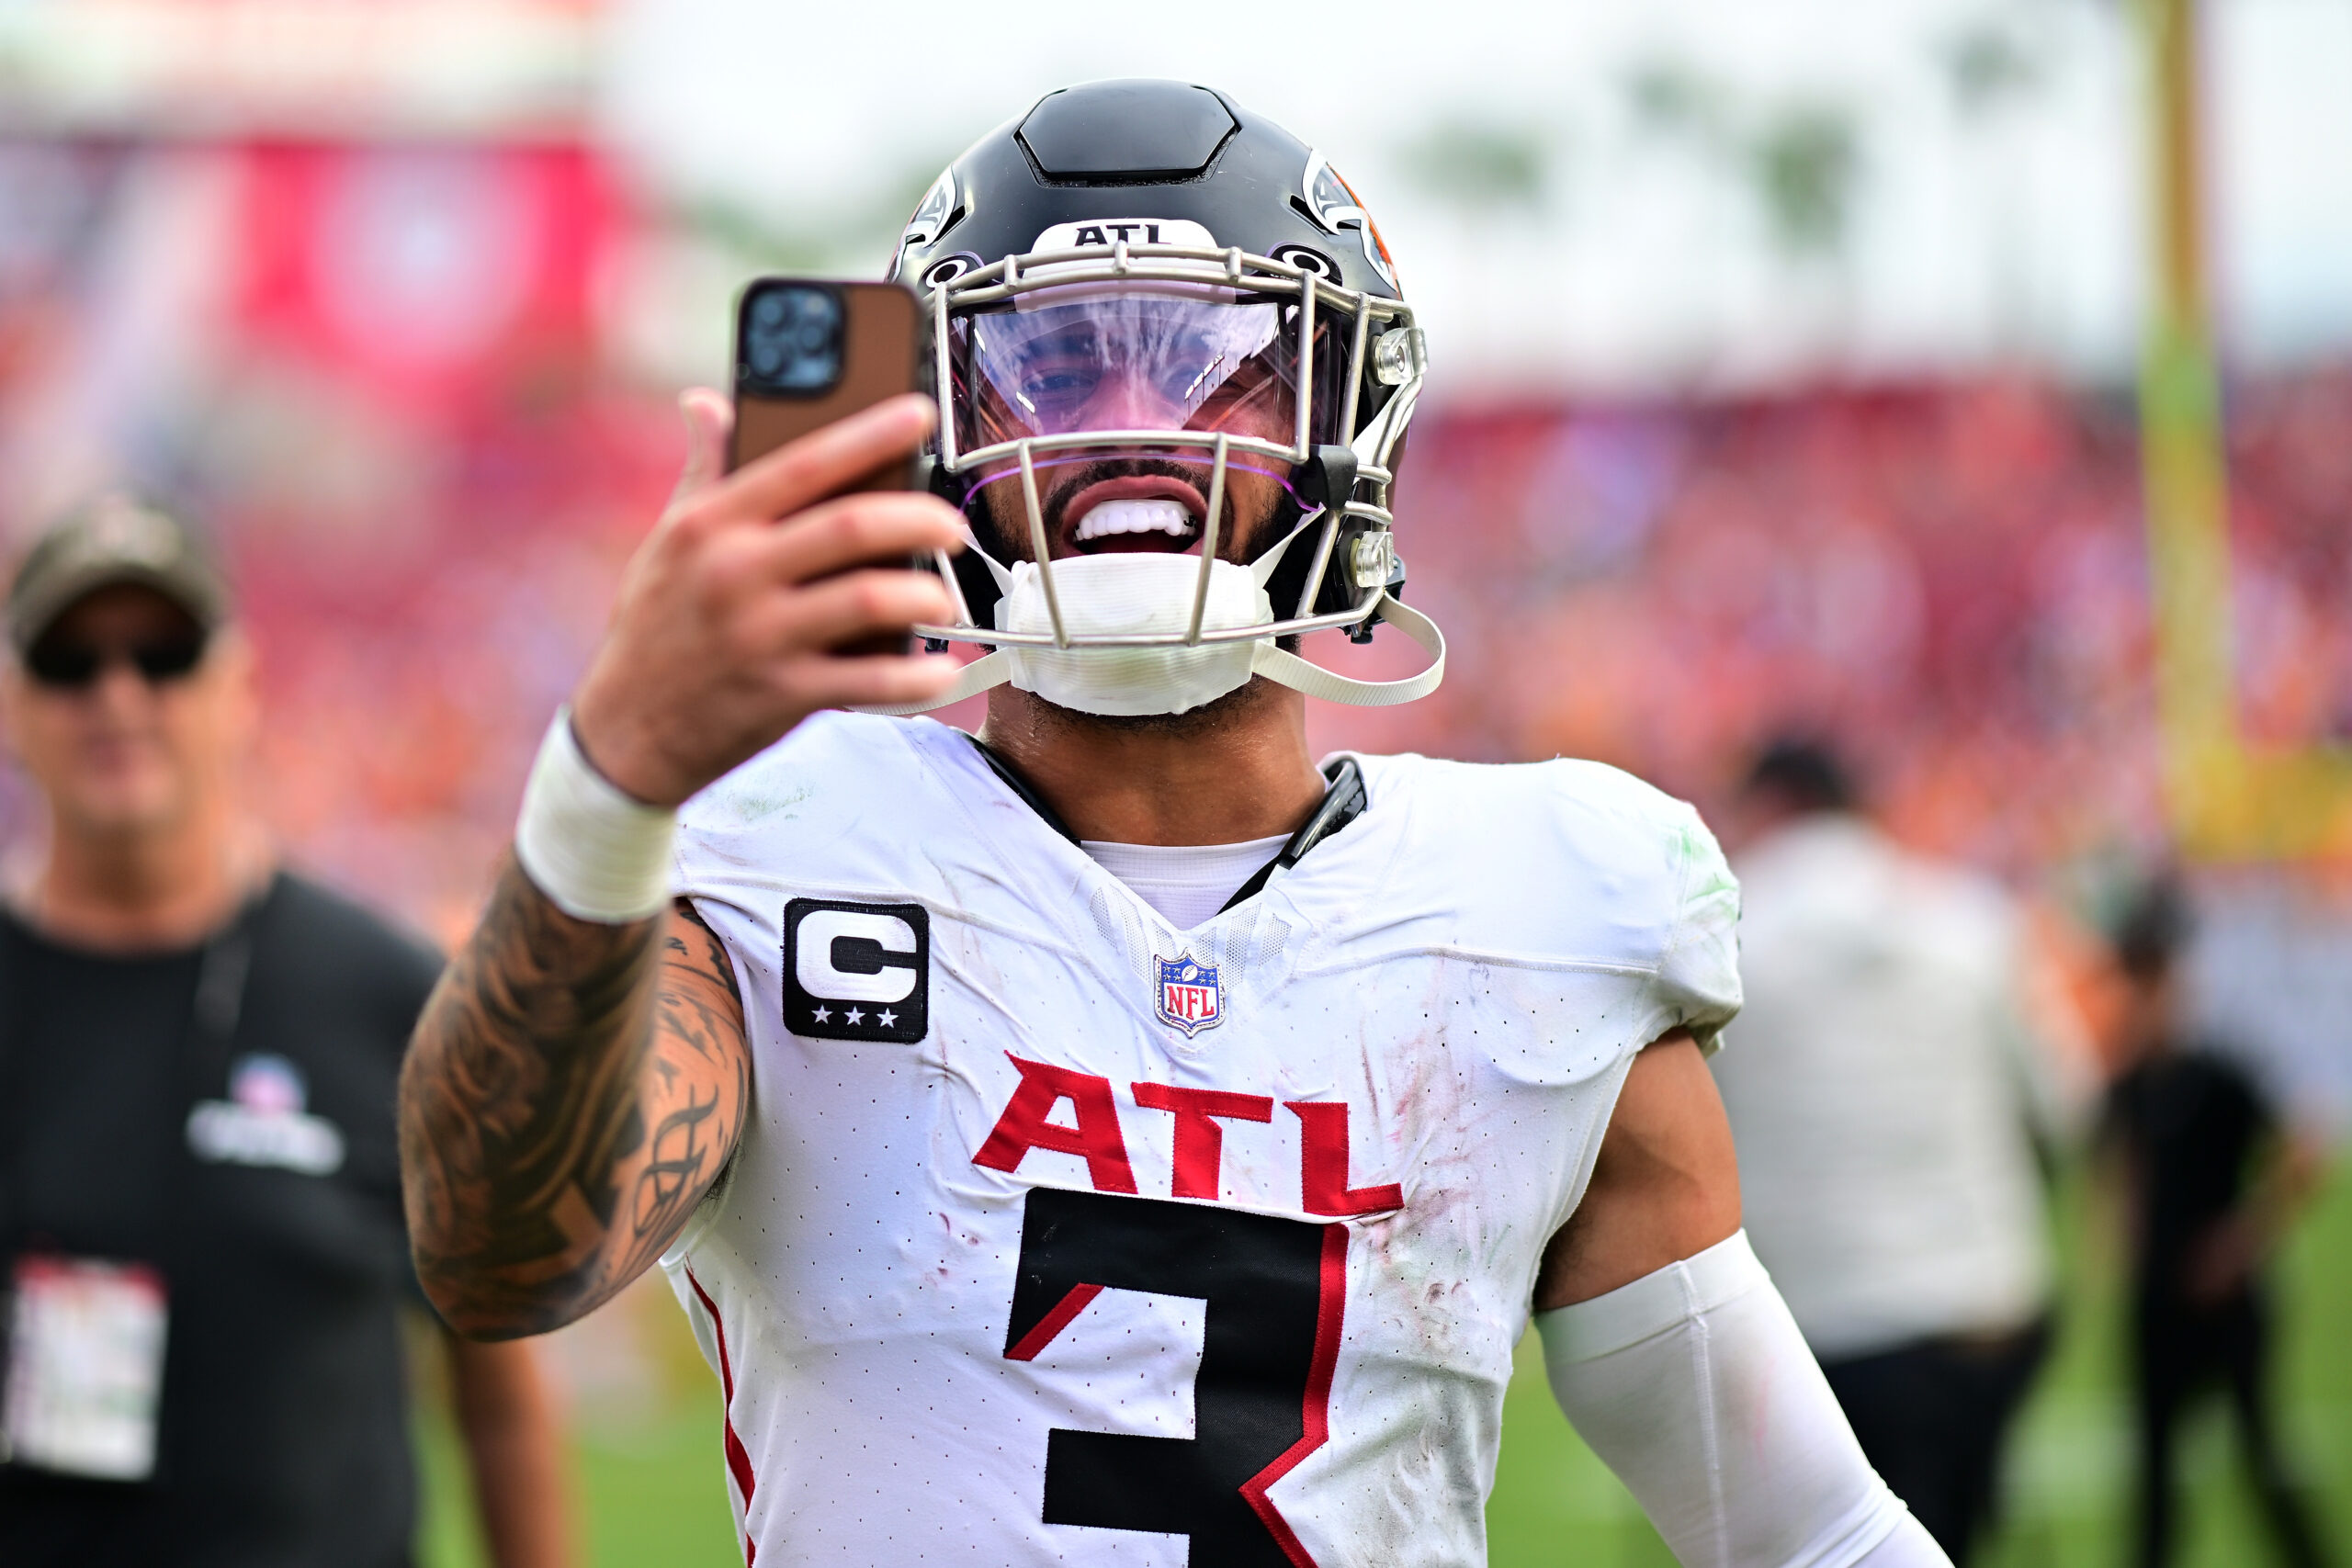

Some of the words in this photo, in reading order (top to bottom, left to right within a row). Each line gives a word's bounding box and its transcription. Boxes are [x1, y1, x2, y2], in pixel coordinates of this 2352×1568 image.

[1075, 224, 1171, 246] ATL
[796, 909, 917, 1003] C
[1166, 986, 1215, 1021] NFL
[971, 1049, 1404, 1216] ATL
[1003, 1187, 1350, 1568] 3
